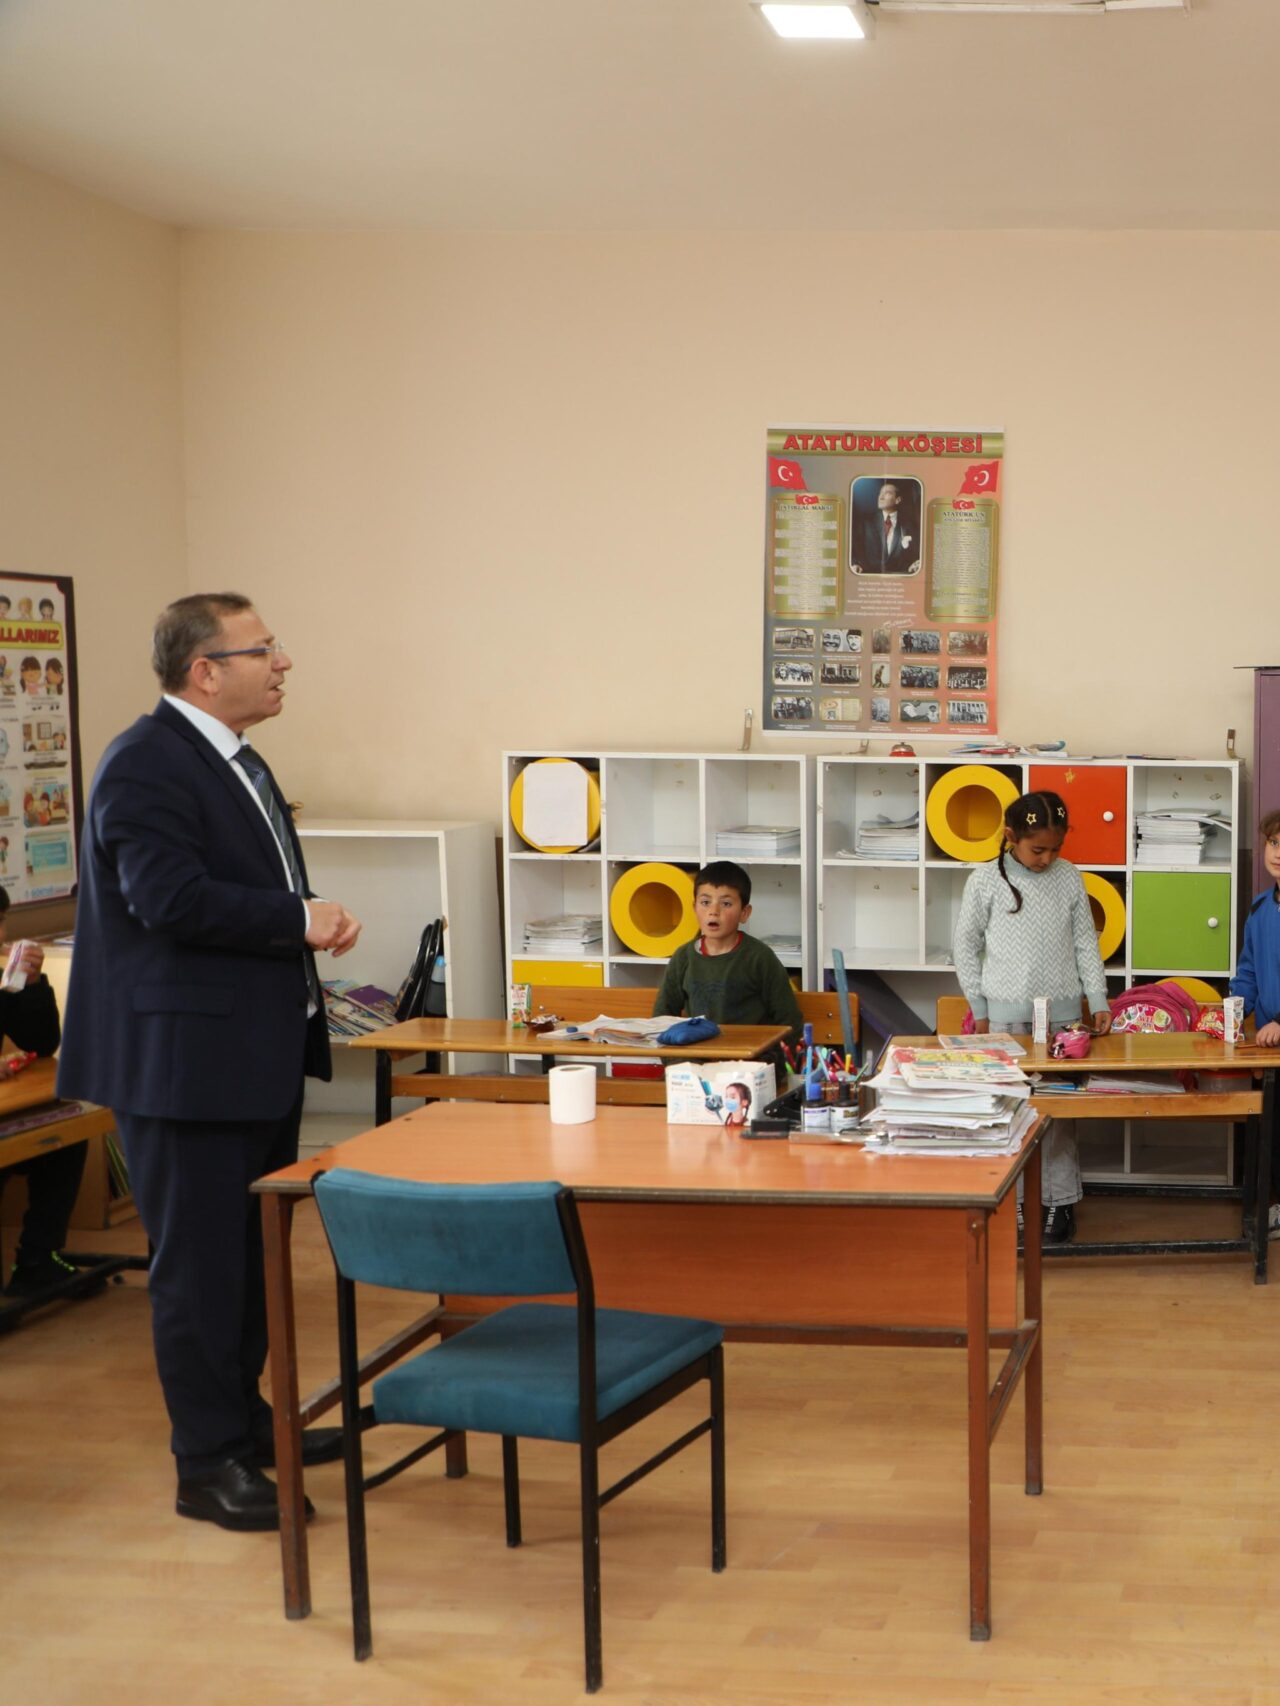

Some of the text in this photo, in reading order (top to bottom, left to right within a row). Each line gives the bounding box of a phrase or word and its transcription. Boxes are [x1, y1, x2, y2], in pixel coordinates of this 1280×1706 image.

[783, 433, 983, 456] ATATÜRK KÖŞESİ
[0, 627, 60, 643] LLARIMIZ
